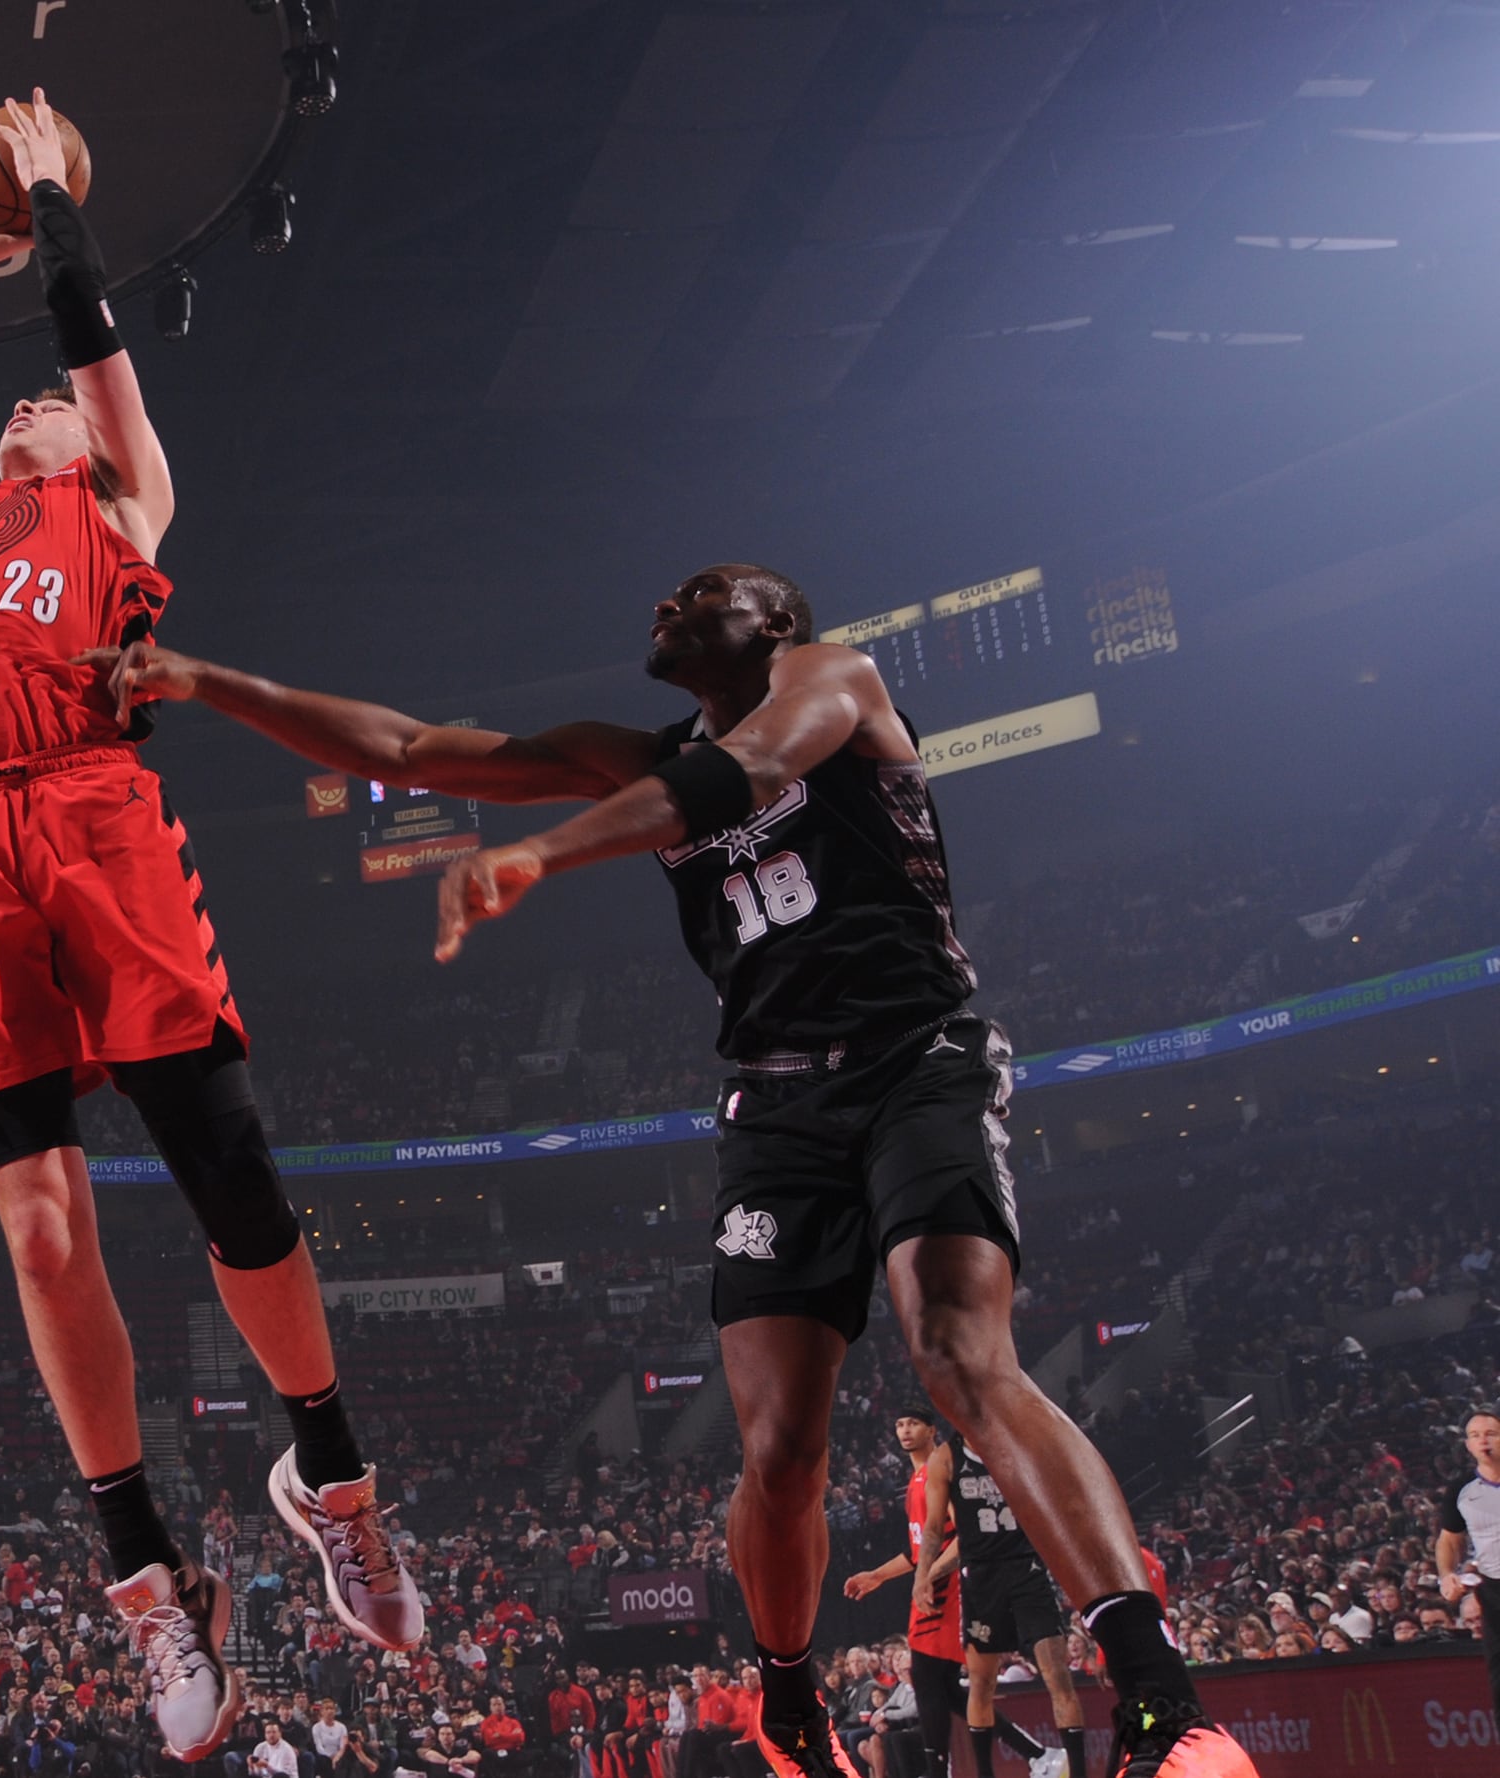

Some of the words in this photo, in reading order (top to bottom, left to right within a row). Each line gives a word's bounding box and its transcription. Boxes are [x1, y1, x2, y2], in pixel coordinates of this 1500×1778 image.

[959, 576, 1013, 600] GUEST
[1086, 585, 1171, 623] ripcity
[848, 614, 892, 635] HOME
[1091, 609, 1175, 645] ripcity
[1093, 629, 1180, 665] ripcity
[949, 741, 977, 758] Go
[982, 724, 1043, 749] Places
[725, 854, 823, 951] 18
[1239, 1011, 1290, 1035] YOUR
[1293, 988, 1388, 1021] PREMIERE
[1391, 963, 1482, 998] PARTNER
[1116, 1028, 1213, 1058] RIVERSIDE
[1118, 1051, 1179, 1069] PAYMENTS
[580, 1119, 666, 1141] RIVERSIDE
[320, 1150, 391, 1165] PARTNER
[396, 1147, 412, 1161] IN
[417, 1141, 503, 1160] PAYMENTS
[581, 1136, 635, 1151] PAYMENTS
[89, 1161, 168, 1173] RIVERSIDE
[379, 1287, 424, 1309] CITY
[429, 1287, 477, 1306] ROW
[622, 1581, 694, 1611] moda
[664, 1611, 695, 1621] HEALTH
